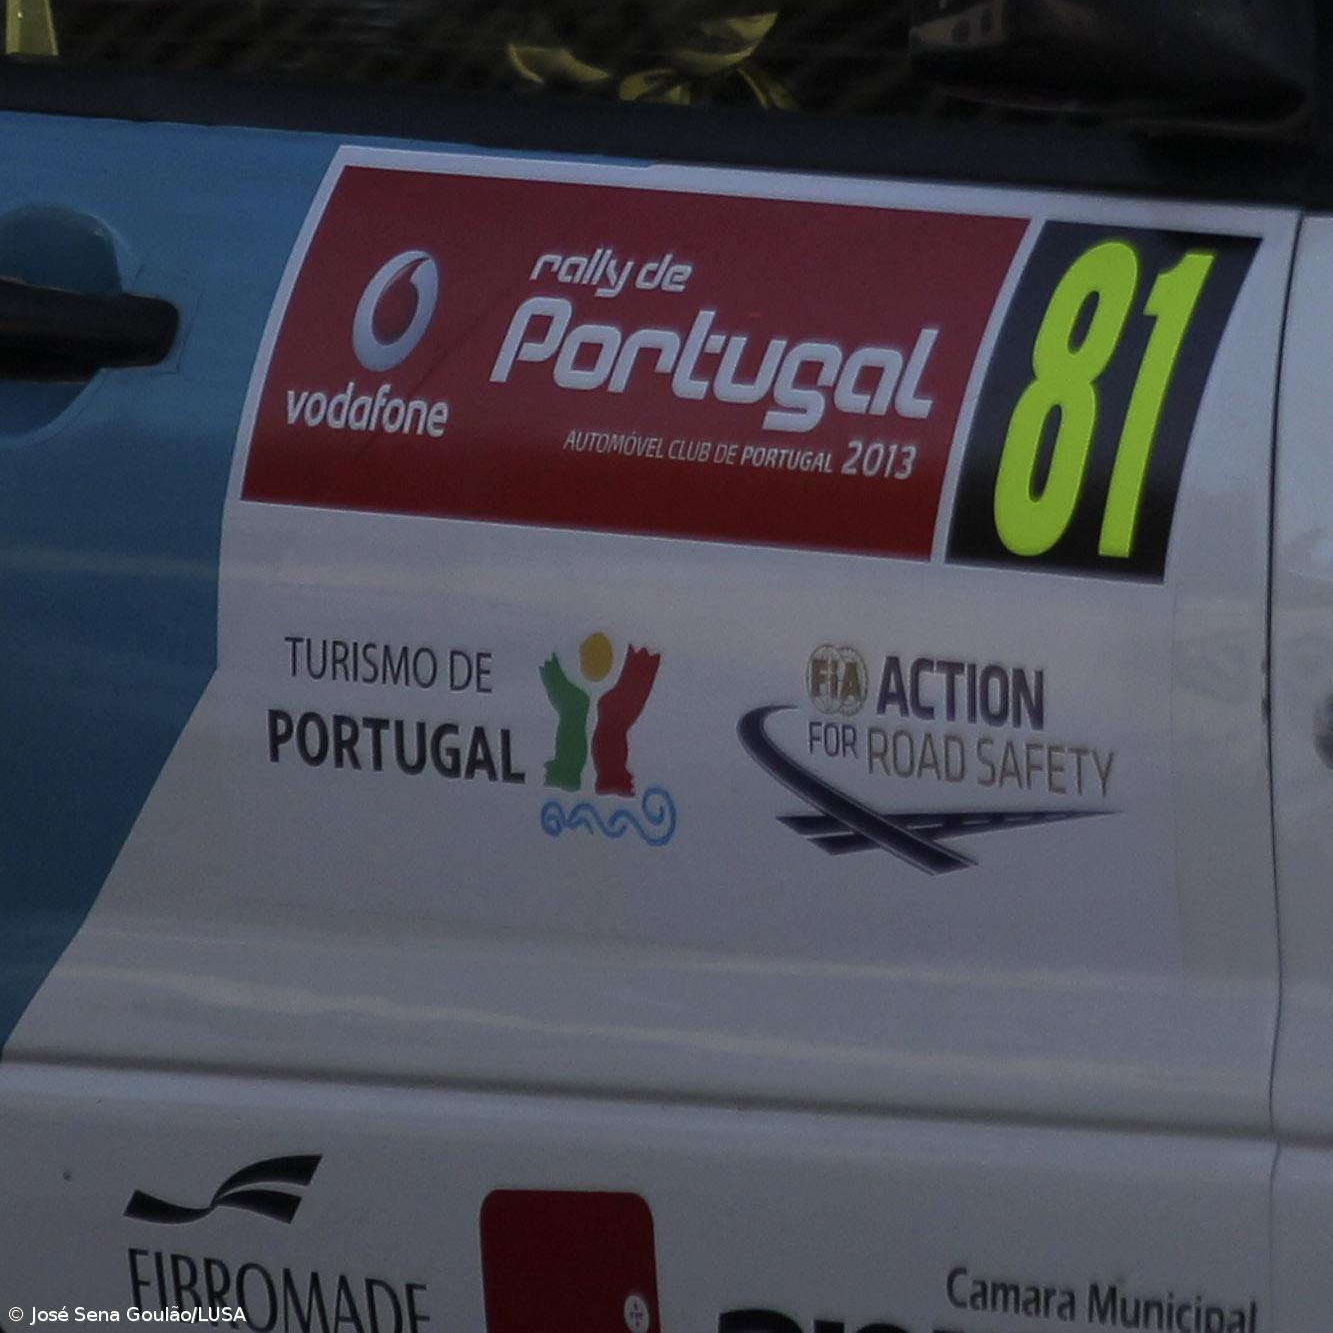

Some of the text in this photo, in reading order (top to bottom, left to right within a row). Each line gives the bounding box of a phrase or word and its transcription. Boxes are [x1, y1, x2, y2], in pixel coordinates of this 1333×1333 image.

[530, 247, 692, 298] rally de
[489, 295, 938, 433] Portugal
[286, 382, 449, 437] vodafone
[993, 241, 1215, 559] 81
[563, 430, 917, 480] AUTOMÓVEL CLUB DE PORTUGAL 2013
[284, 635, 493, 694] TURISMO DE
[876, 655, 1046, 730] ACTION
[267, 708, 526, 784] PORTUGAL
[809, 721, 1115, 798] FOR ROAD SAFETY
[945, 1267, 1258, 1333] Camara Municipal
